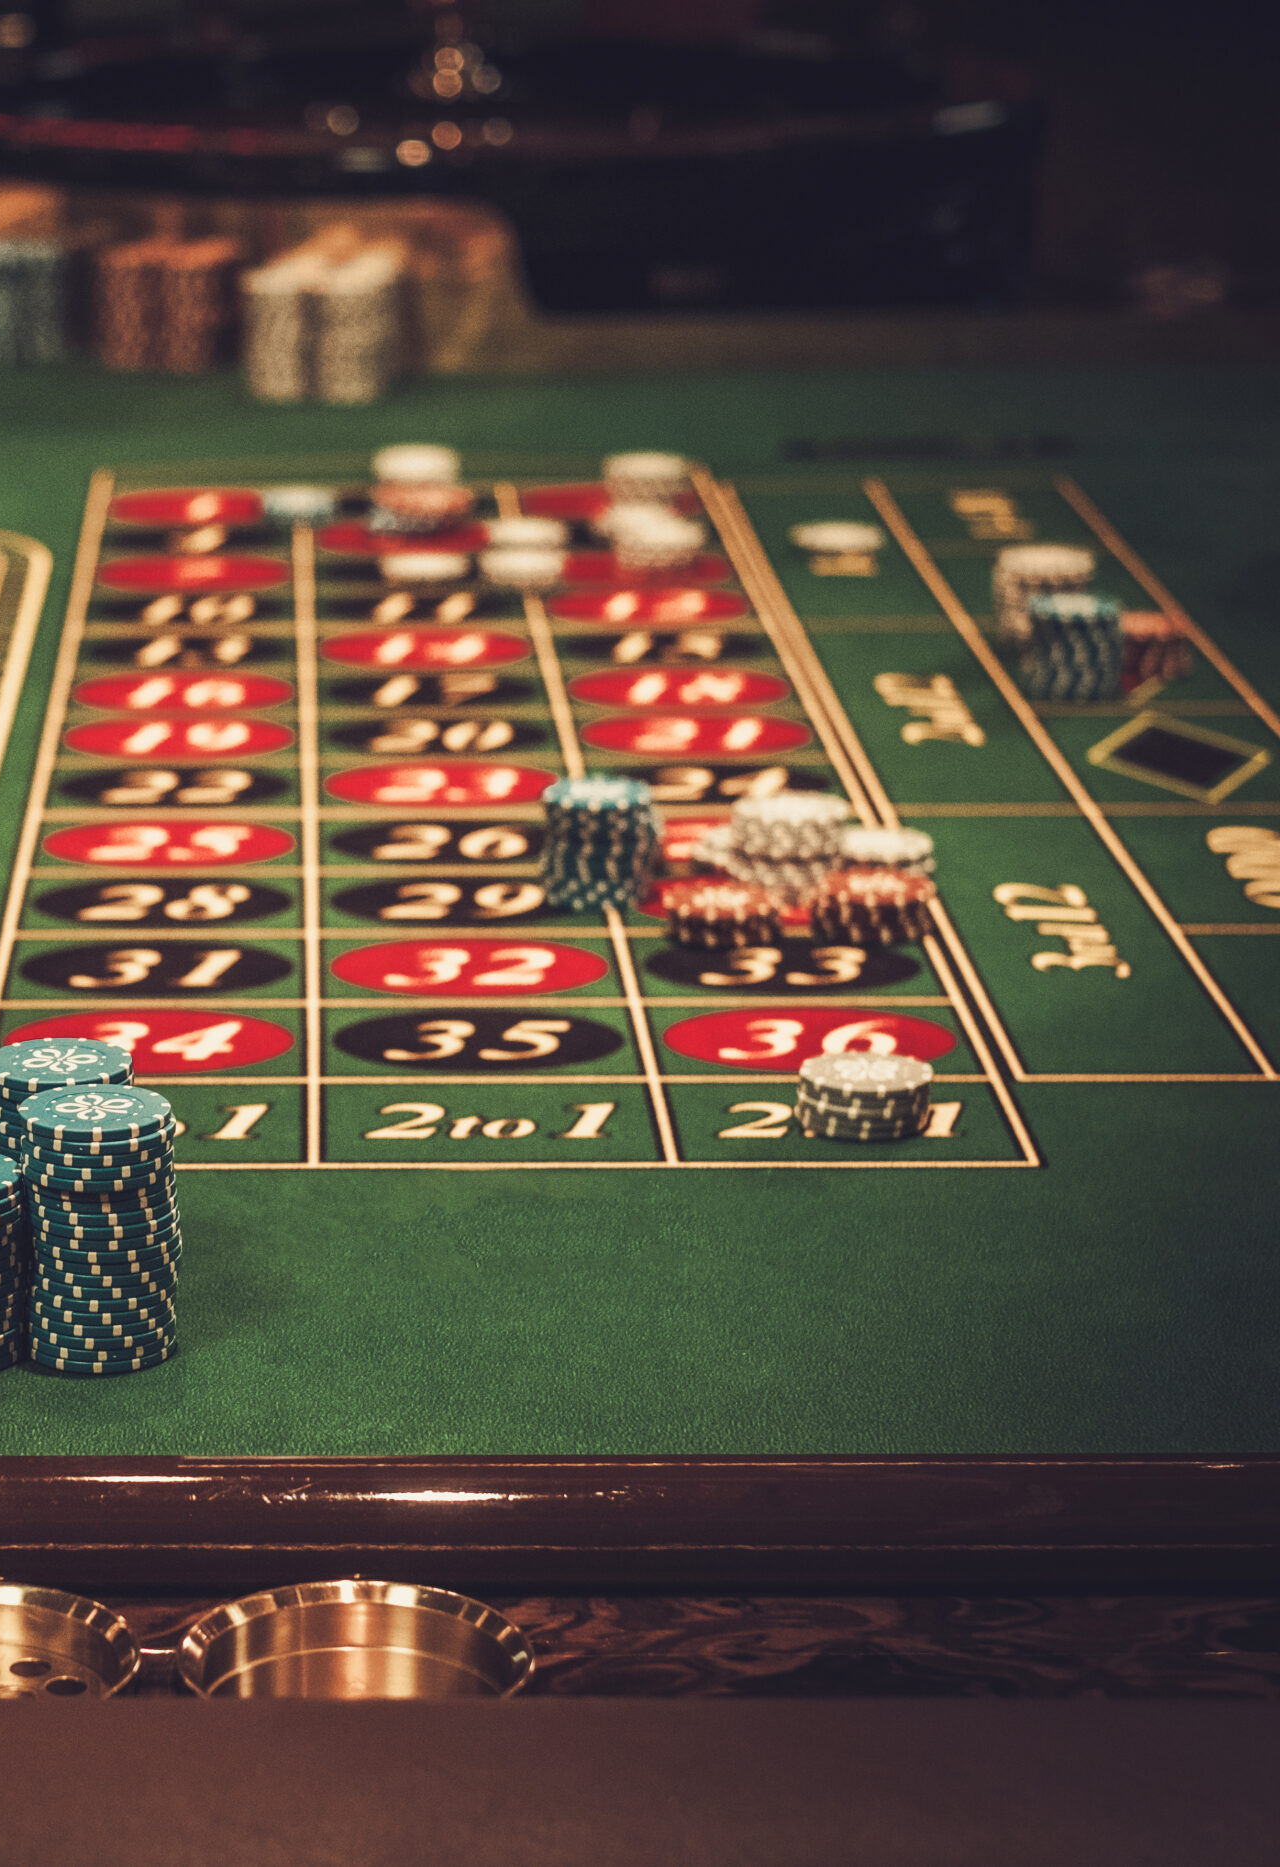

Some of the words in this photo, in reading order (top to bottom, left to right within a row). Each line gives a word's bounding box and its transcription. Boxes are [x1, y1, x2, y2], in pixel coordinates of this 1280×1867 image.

[101, 769, 253, 804] 22
[87, 825, 253, 862] 25
[372, 823, 529, 861] 26
[76, 883, 252, 921] 28
[379, 882, 546, 921] 29
[68, 948, 242, 987] 31
[383, 947, 557, 988] 32
[699, 946, 868, 986] 33
[93, 1020, 243, 1061] 34
[383, 1019, 571, 1061] 35
[718, 1018, 898, 1060] 36
[550, 1102, 616, 1140] 1
[718, 1101, 793, 1139] 2
